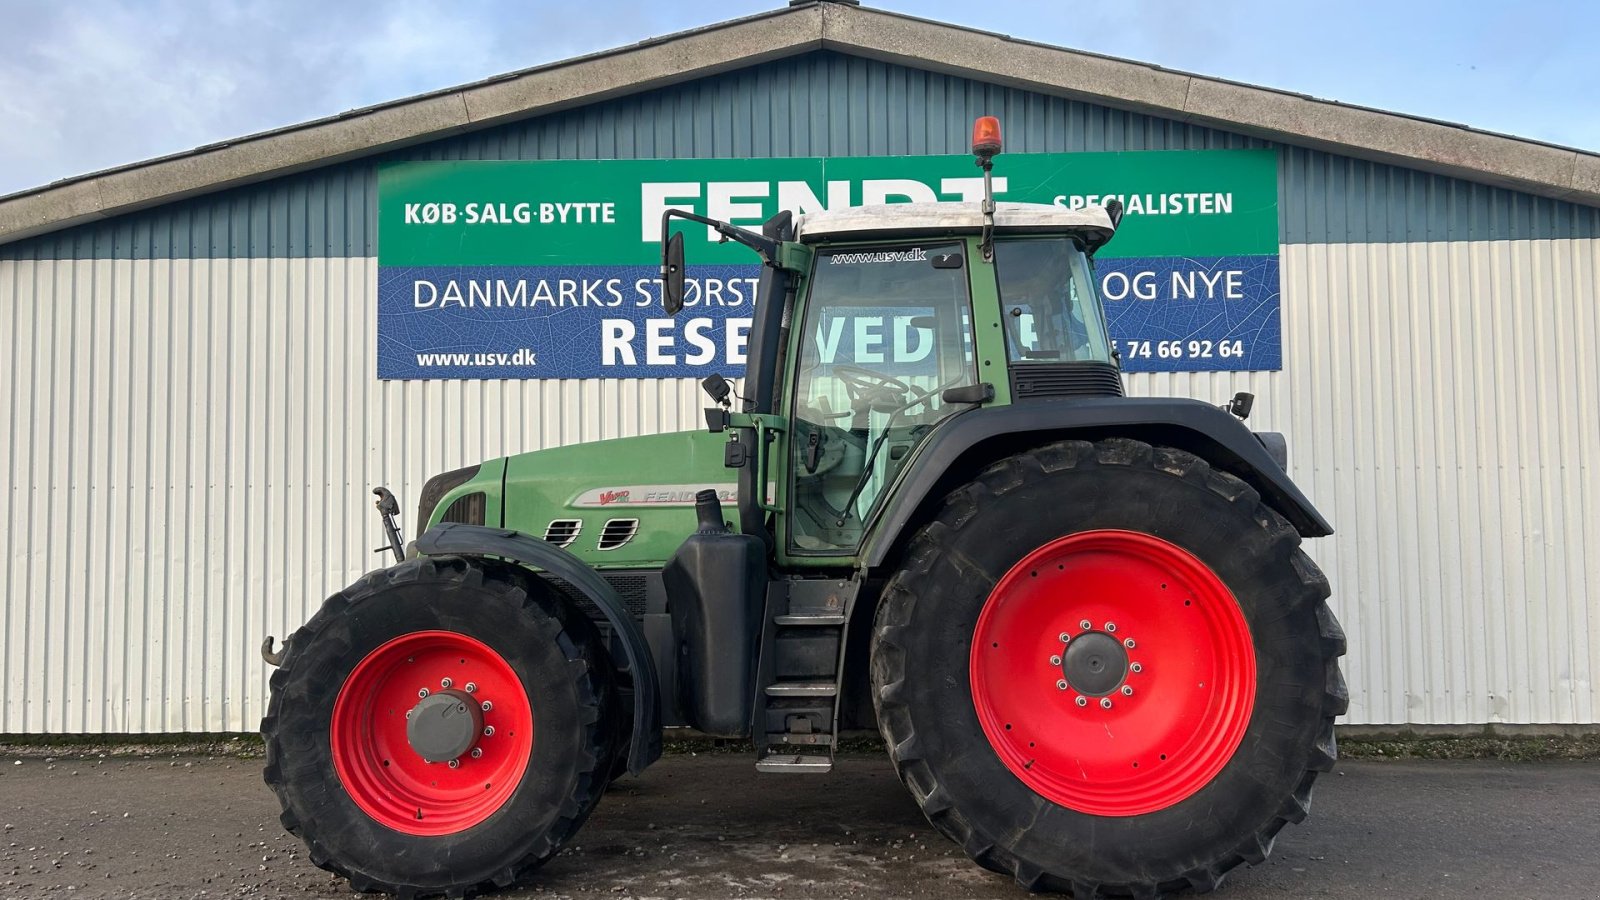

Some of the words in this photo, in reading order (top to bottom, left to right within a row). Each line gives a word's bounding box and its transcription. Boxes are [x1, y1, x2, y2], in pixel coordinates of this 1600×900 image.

[830, 247, 927, 265] www.usv.dk
[414, 279, 623, 308] DANMARKS
[1102, 271, 1156, 300] OG
[1172, 271, 1243, 299] NYE
[416, 347, 536, 367] www.usv.dk
[1127, 341, 1152, 359] 74
[1157, 340, 1182, 358] 66
[1188, 340, 1213, 358] 92
[1219, 339, 1244, 358] 64
[645, 490, 698, 503] FEND
